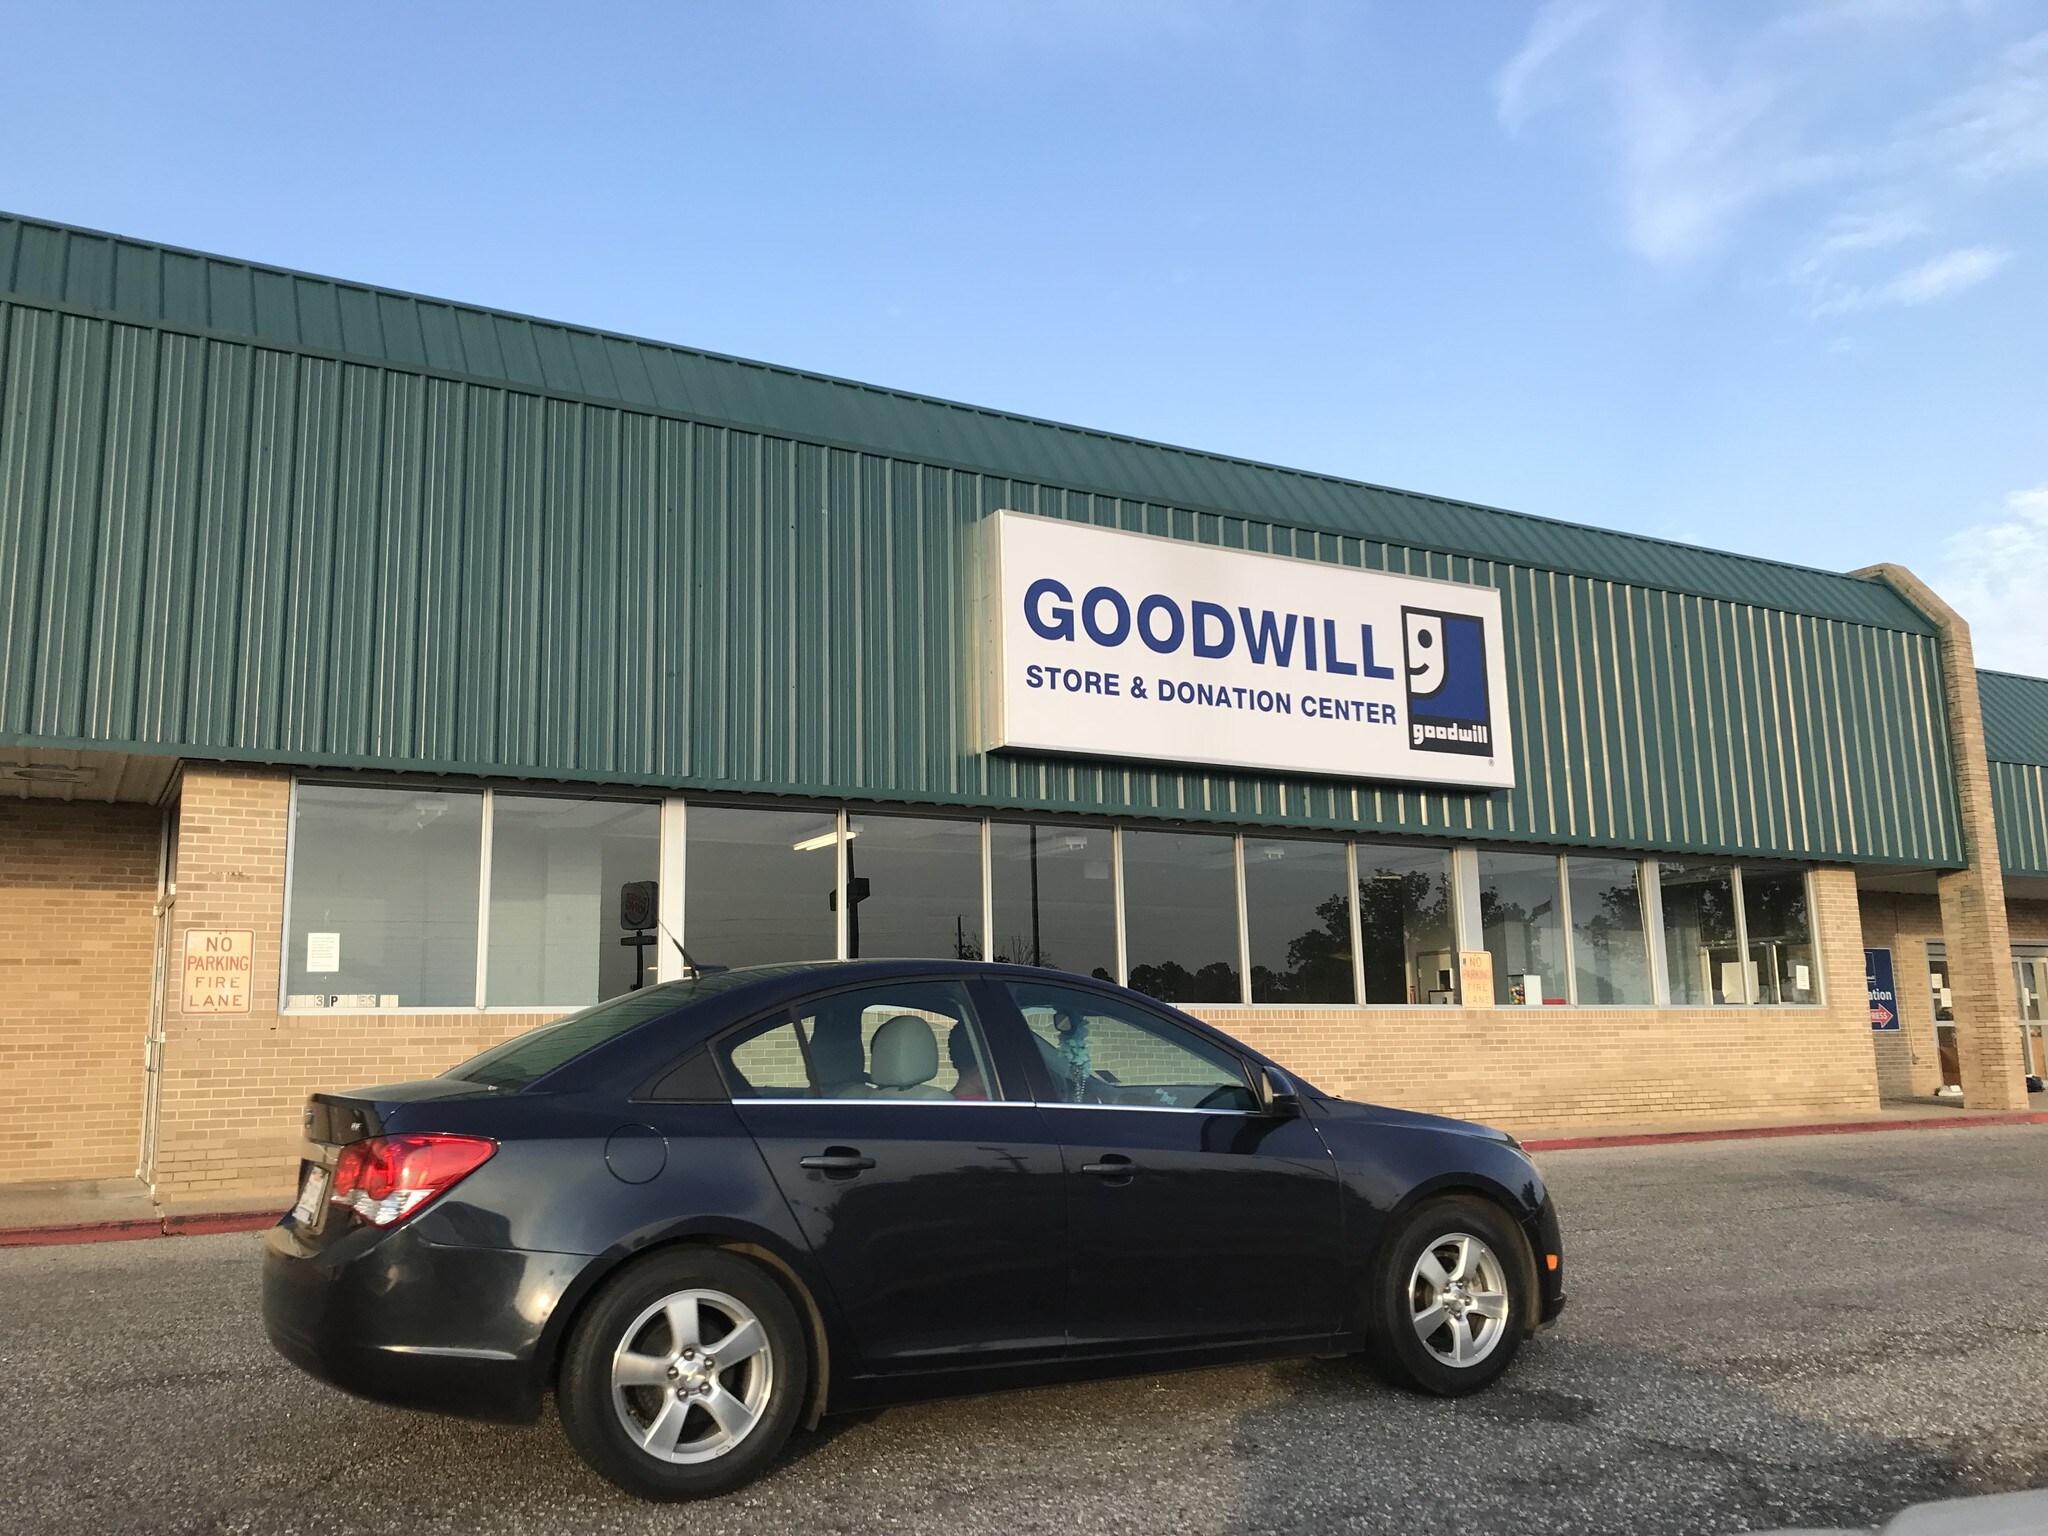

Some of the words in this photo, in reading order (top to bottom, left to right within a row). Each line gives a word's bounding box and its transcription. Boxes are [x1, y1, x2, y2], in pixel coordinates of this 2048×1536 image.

[1023, 578, 1394, 680] GOODWILL
[1026, 665, 1120, 696] STORE
[1130, 676, 1149, 699] &
[1158, 680, 1292, 715] DONATION
[1301, 695, 1396, 725] CENTER
[1412, 722, 1488, 745] goodwill
[206, 937, 232, 952] NO
[187, 956, 249, 971] PARKING
[1469, 956, 1482, 968] NO
[1463, 969, 1491, 980] PARKING
[195, 976, 240, 989] FIRE
[1467, 983, 1488, 992] FIRE
[189, 994, 242, 1007] LANE
[1466, 995, 1490, 1004] LANE
